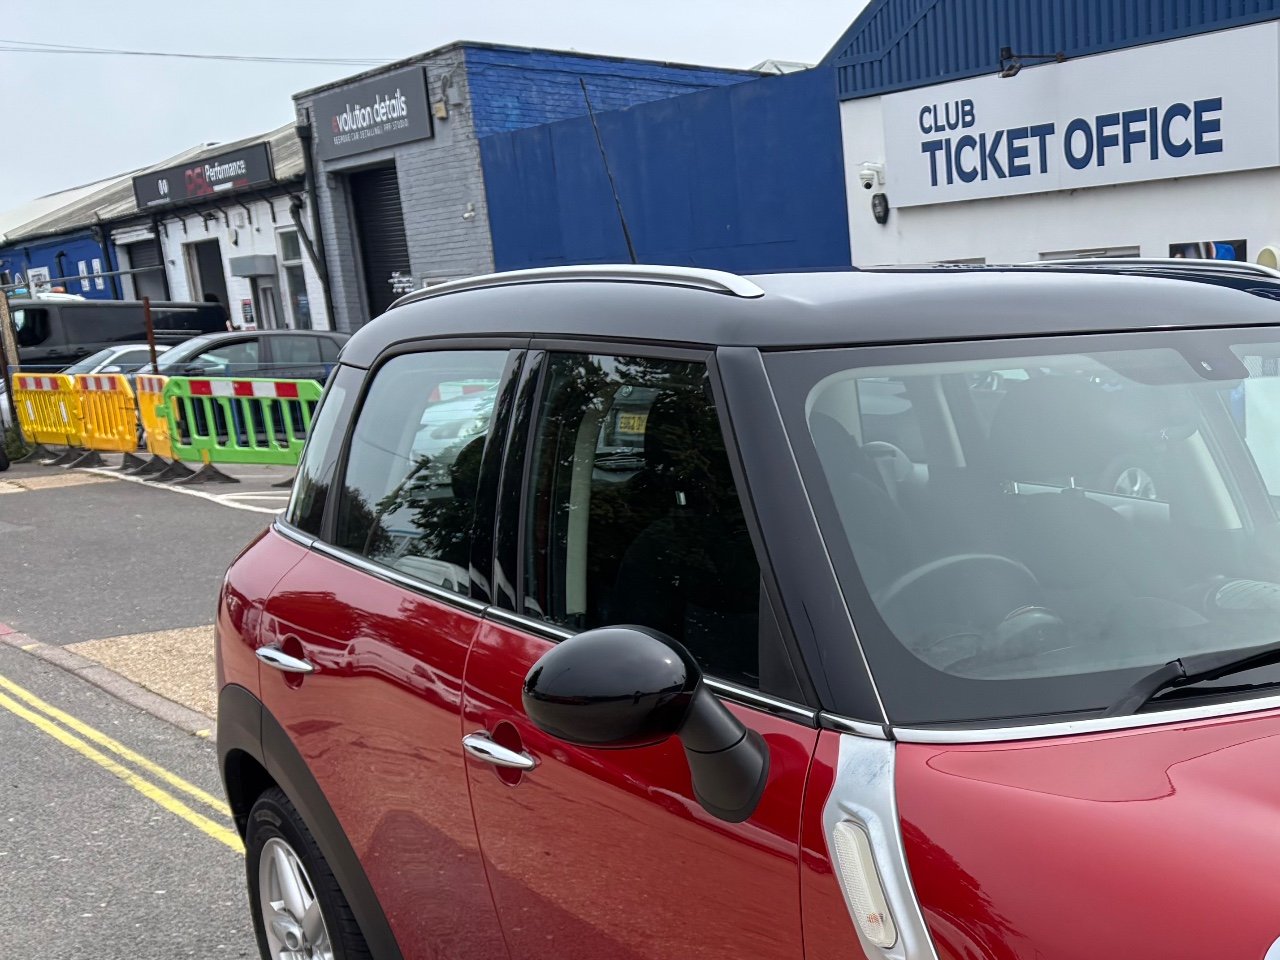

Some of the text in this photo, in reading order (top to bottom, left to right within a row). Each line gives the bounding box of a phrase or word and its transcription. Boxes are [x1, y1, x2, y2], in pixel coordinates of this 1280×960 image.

[331, 87, 408, 134] evolution details
[919, 98, 976, 135] CLUB
[921, 96, 1223, 187] TICKET OFFICE
[204, 159, 247, 182] Performance
